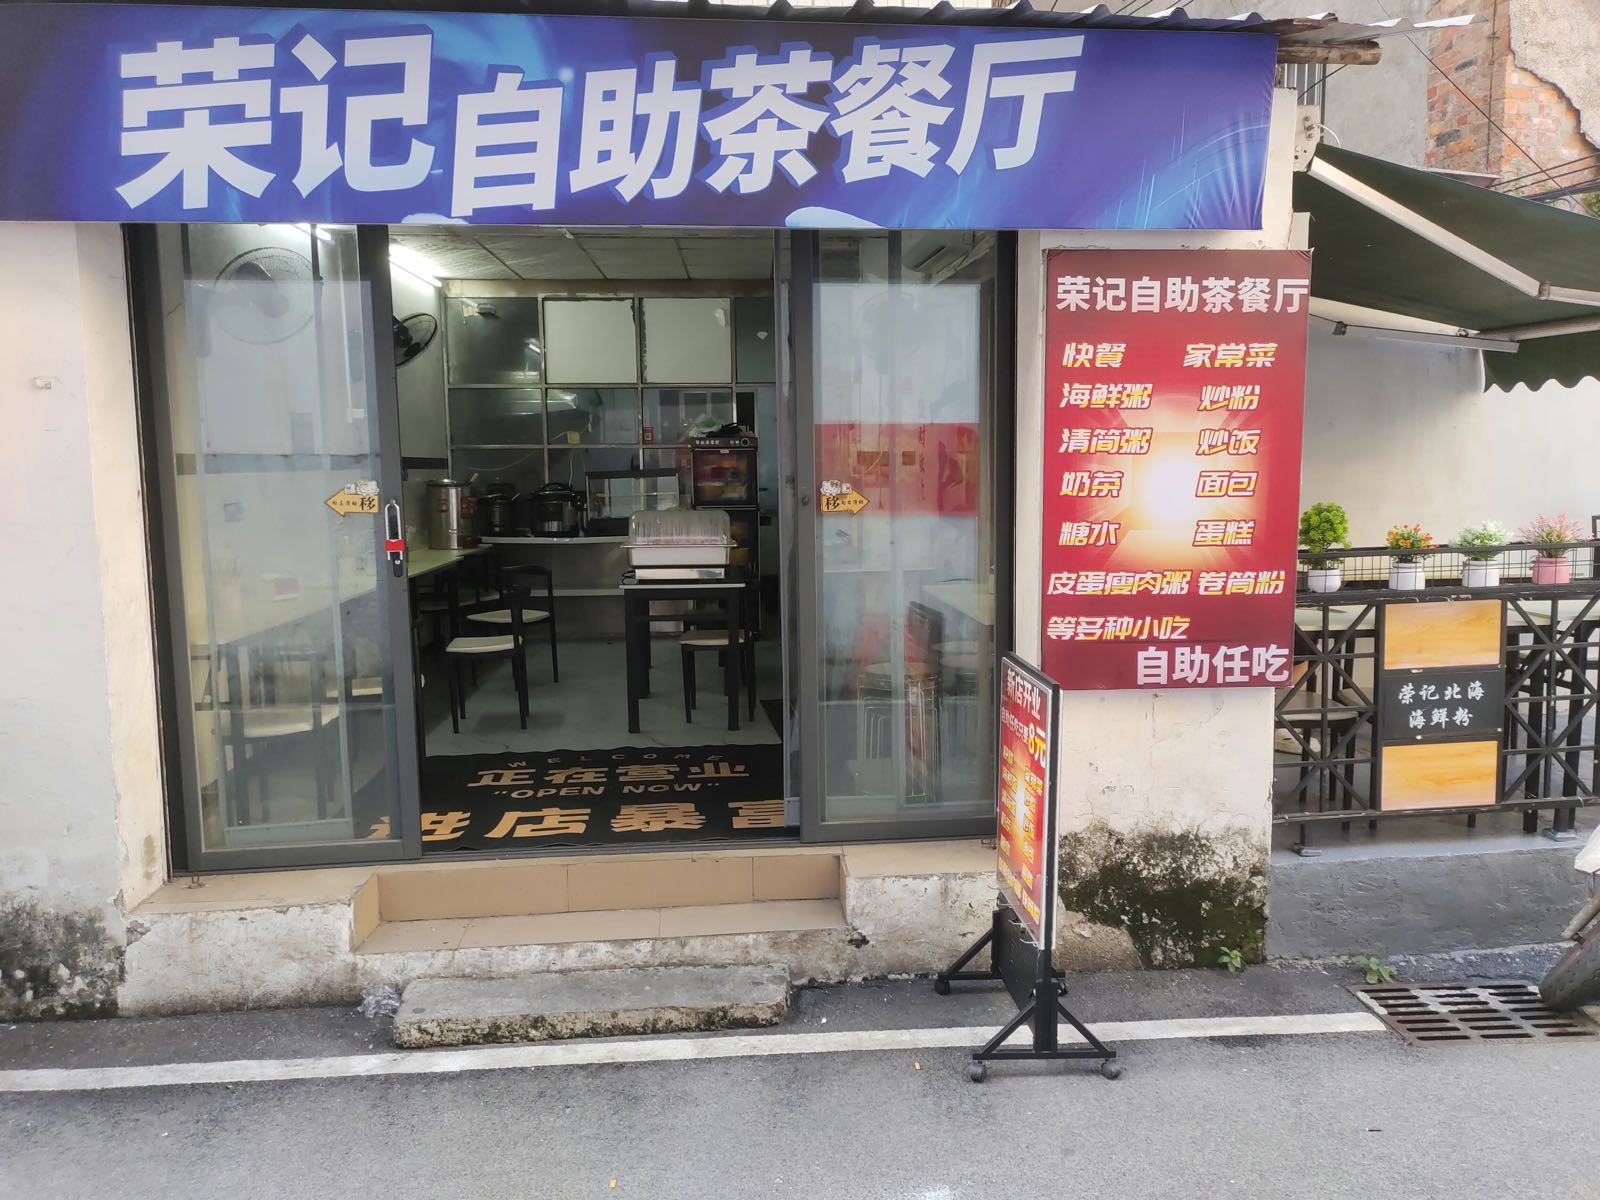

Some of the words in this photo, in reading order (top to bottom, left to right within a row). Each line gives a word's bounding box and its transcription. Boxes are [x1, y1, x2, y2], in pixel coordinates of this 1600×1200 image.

[116, 34, 1085, 216] 荣记自助茶餐厅
[1055, 275, 1309, 314] 荣记自助茶餐厅
[1062, 342, 1126, 368] 快餐
[1183, 342, 1278, 368] 家常菜
[1059, 382, 1153, 409] 海鲜粥
[1199, 384, 1261, 410] 炒粉
[1197, 428, 1261, 455] 炒饭
[1060, 471, 1123, 497] 奶茶
[1196, 471, 1258, 497] 面包
[1059, 521, 1119, 546] 糖水
[1194, 520, 1254, 546] 蛋糕
[1047, 570, 1192, 595] 皮蛋瘦肉粥
[1198, 570, 1286, 595] 卷筒粉
[1047, 616, 1191, 640] 等多种小吃
[1136, 644, 1290, 686] 自助任吃
[1006, 667, 1041, 721] 新店开业
[1398, 680, 1485, 704] 荣记北海
[1409, 707, 1474, 729] 海鲜粉
[467, 762, 750, 787] 正在营业
